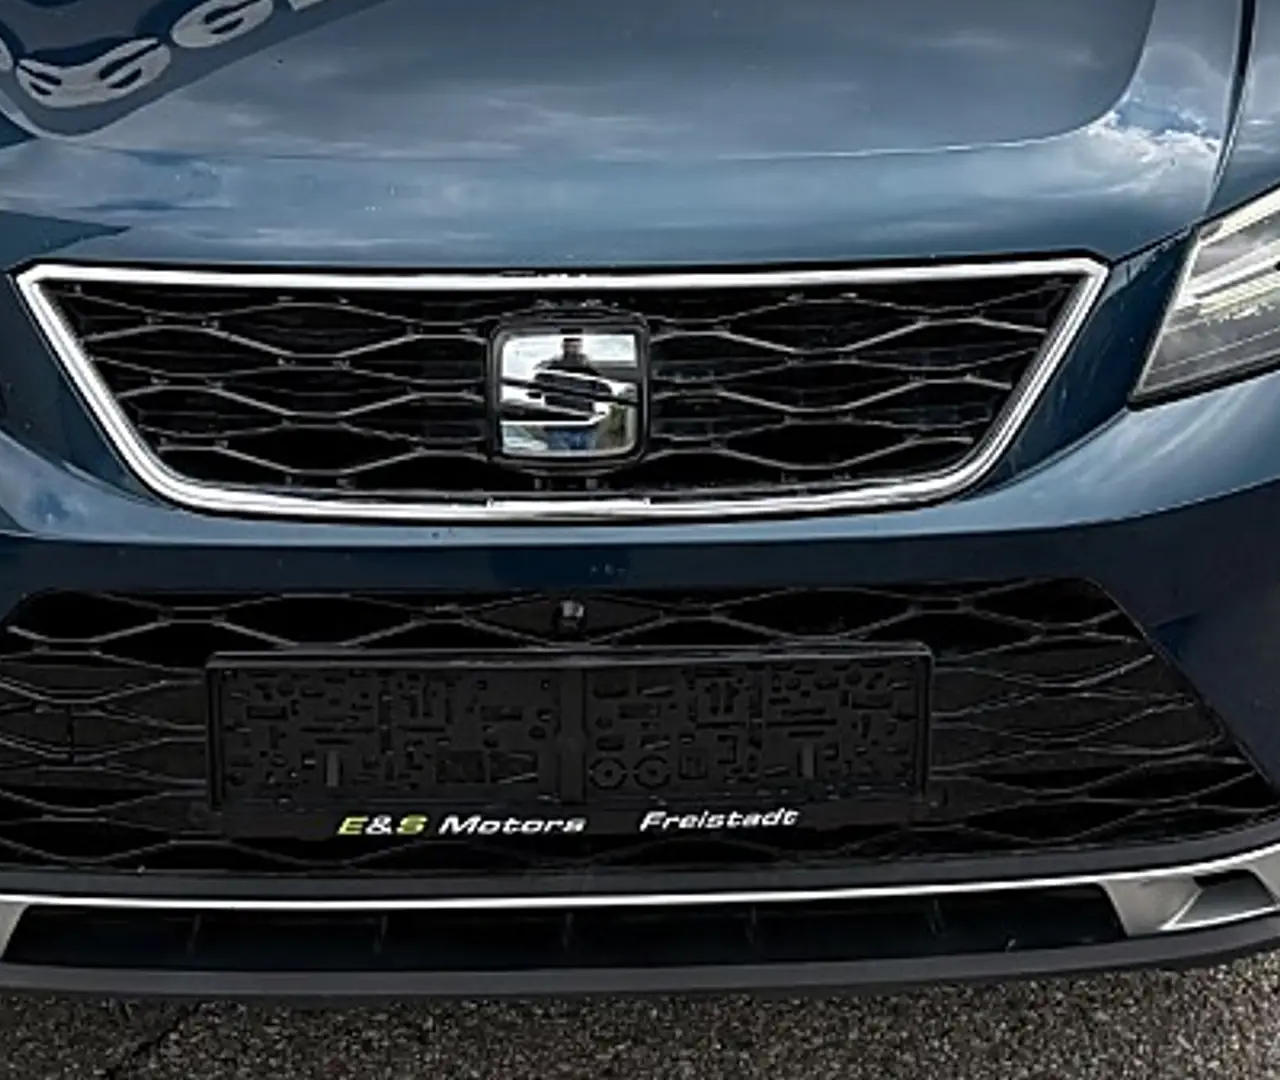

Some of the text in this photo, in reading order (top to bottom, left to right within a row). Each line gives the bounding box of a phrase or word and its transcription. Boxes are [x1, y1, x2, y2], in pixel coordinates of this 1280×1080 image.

[336, 807, 800, 835] E&S Motors Freistadt
